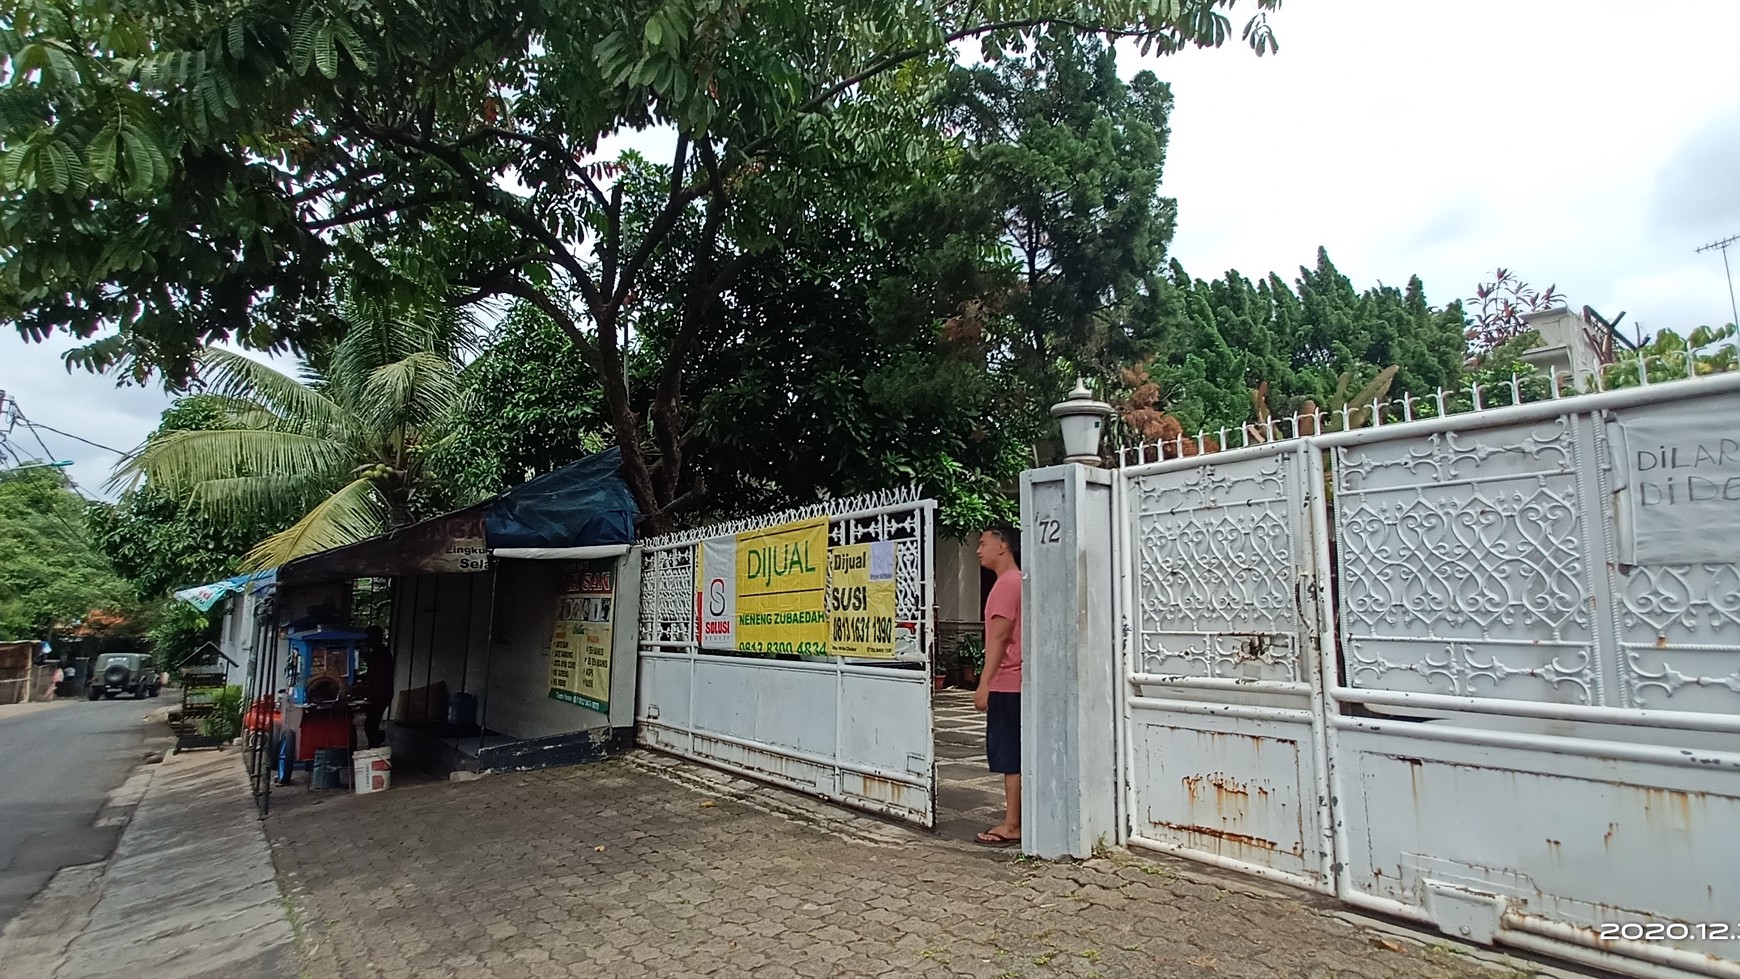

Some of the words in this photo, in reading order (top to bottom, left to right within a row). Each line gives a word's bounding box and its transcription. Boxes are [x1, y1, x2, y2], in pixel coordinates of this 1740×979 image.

[1039, 519, 1060, 544] 72
[747, 540, 816, 587] DIJUAL
[834, 552, 866, 574] Dijual
[832, 586, 867, 611] SUSI
[705, 621, 730, 635] SOLUSI
[739, 613, 772, 626] NENENG
[774, 611, 825, 625] ZUBAEDAH
[833, 617, 850, 642] 0813
[851, 617, 869, 642] 1631
[873, 617, 892, 643] 1390
[797, 641, 827, 657] 4834
